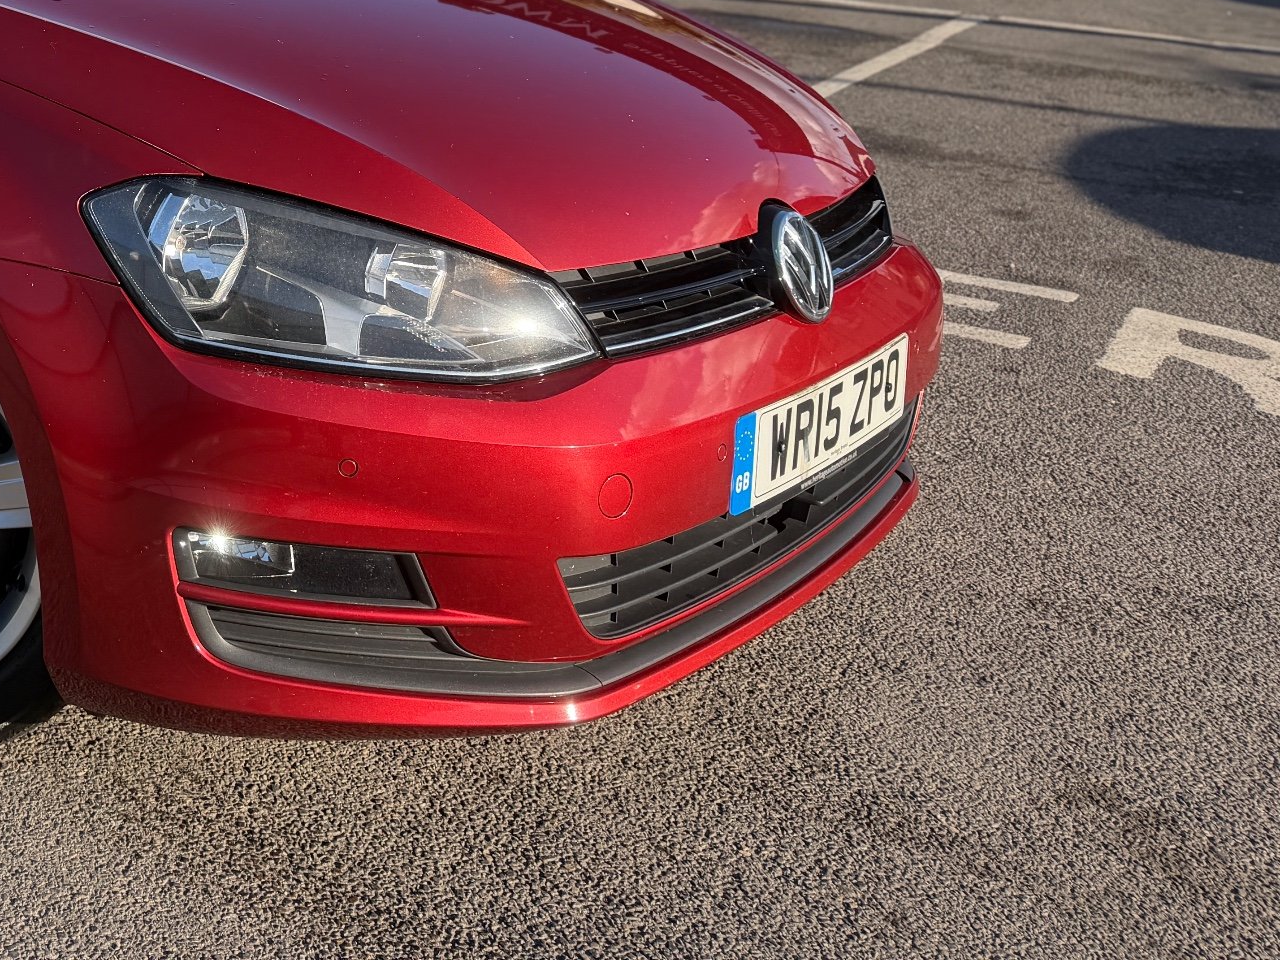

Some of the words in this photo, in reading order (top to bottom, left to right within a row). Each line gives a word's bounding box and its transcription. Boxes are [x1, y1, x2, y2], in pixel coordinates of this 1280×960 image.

[735, 471, 750, 494] GB
[770, 381, 844, 482] WR15
[849, 348, 900, 438] ZPO
